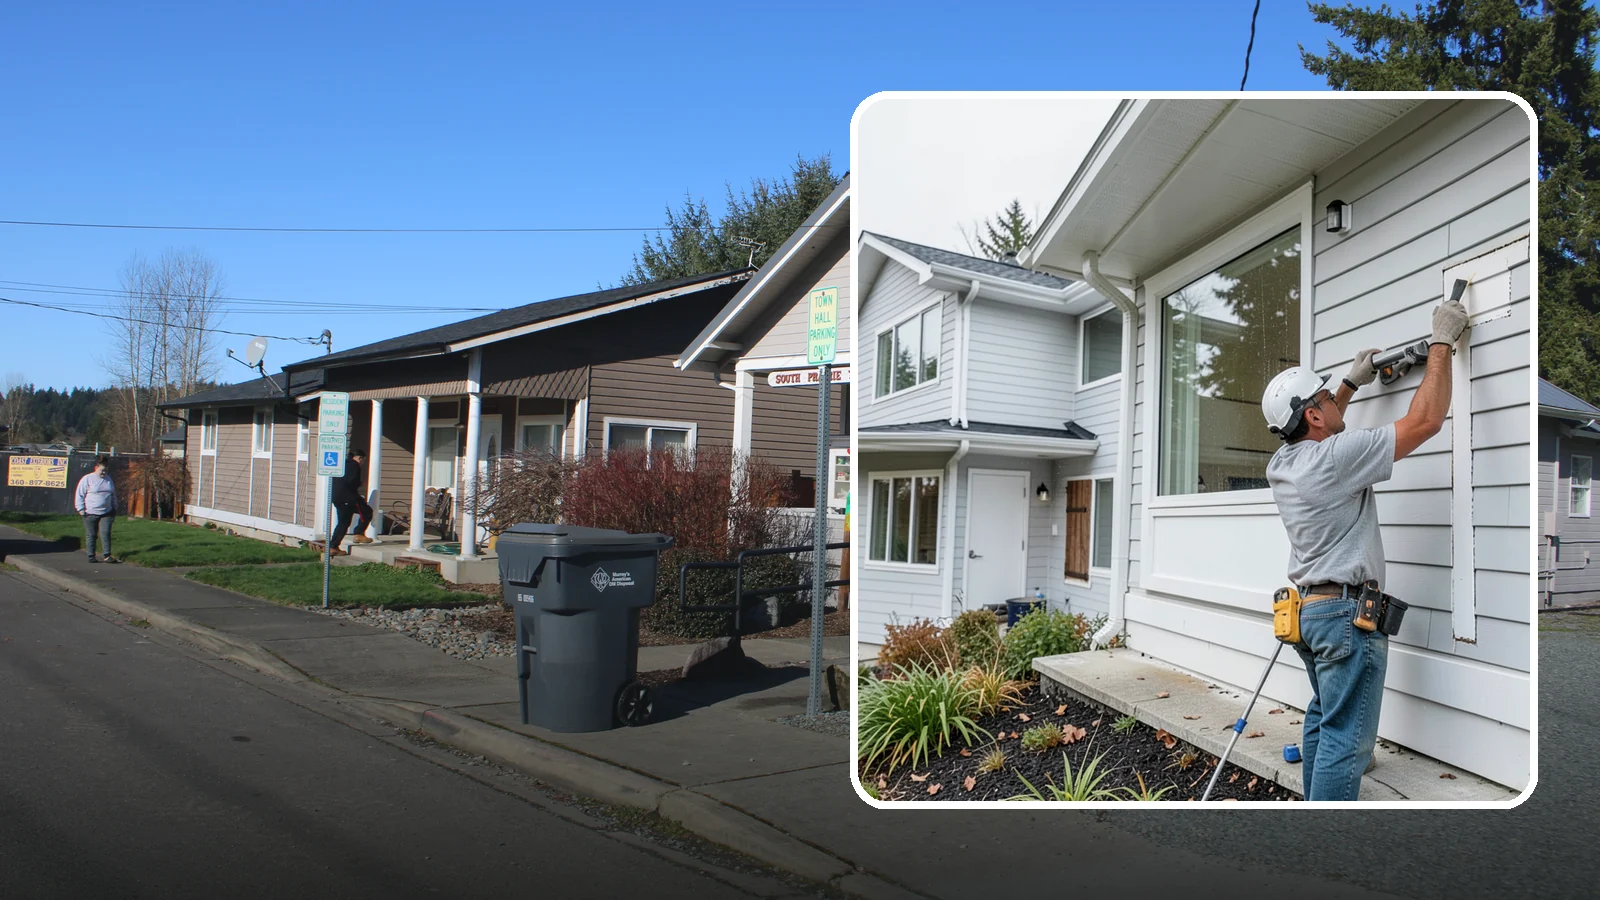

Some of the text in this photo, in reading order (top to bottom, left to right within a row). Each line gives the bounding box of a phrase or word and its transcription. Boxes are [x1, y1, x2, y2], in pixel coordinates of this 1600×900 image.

[815, 294, 833, 308] TOWN
[814, 311, 831, 324] HALL
[810, 327, 836, 341] PARKING
[813, 345, 831, 357] ONLY
[775, 373, 801, 384] SOUTH
